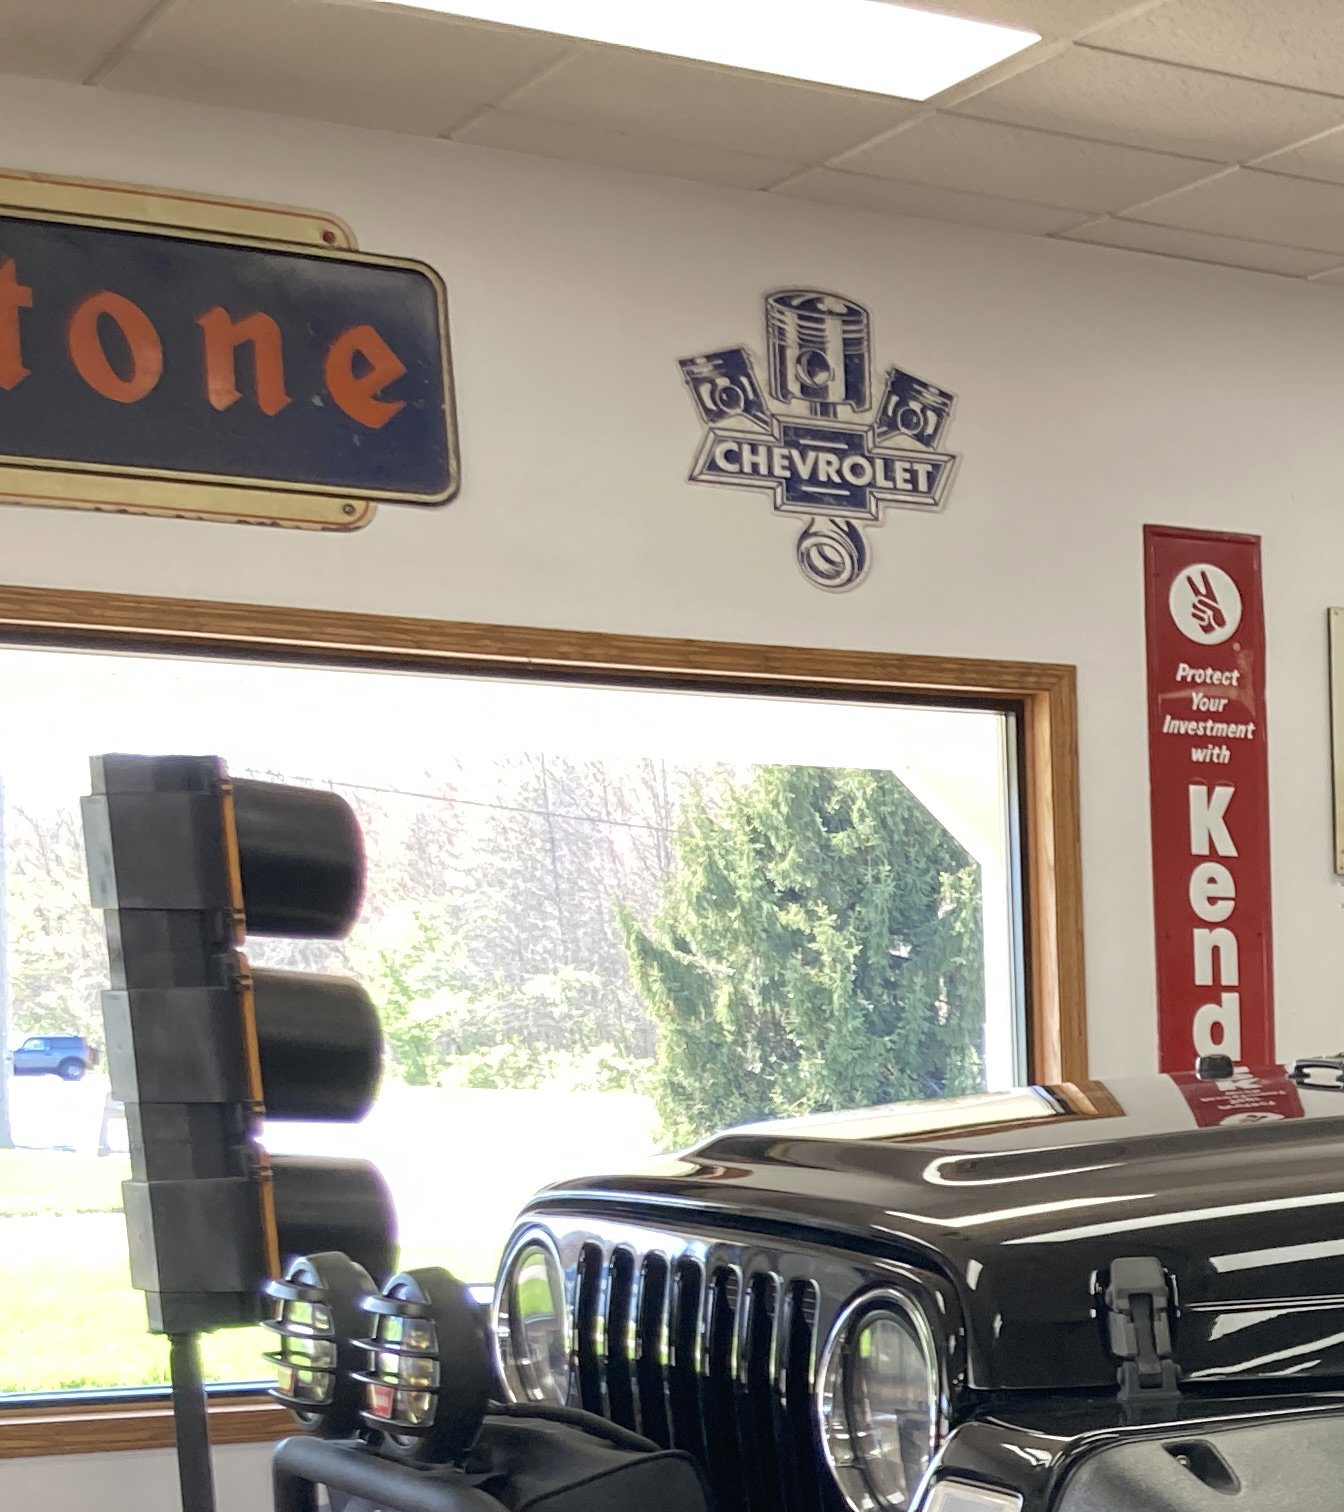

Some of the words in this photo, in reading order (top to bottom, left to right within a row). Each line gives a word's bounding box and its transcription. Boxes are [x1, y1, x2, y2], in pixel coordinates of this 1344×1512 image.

[714, 441, 932, 493] CHEVROLET
[1175, 662, 1241, 686] Protect
[1191, 691, 1228, 712] Your
[1162, 714, 1256, 739] Investment
[1191, 743, 1231, 764] with
